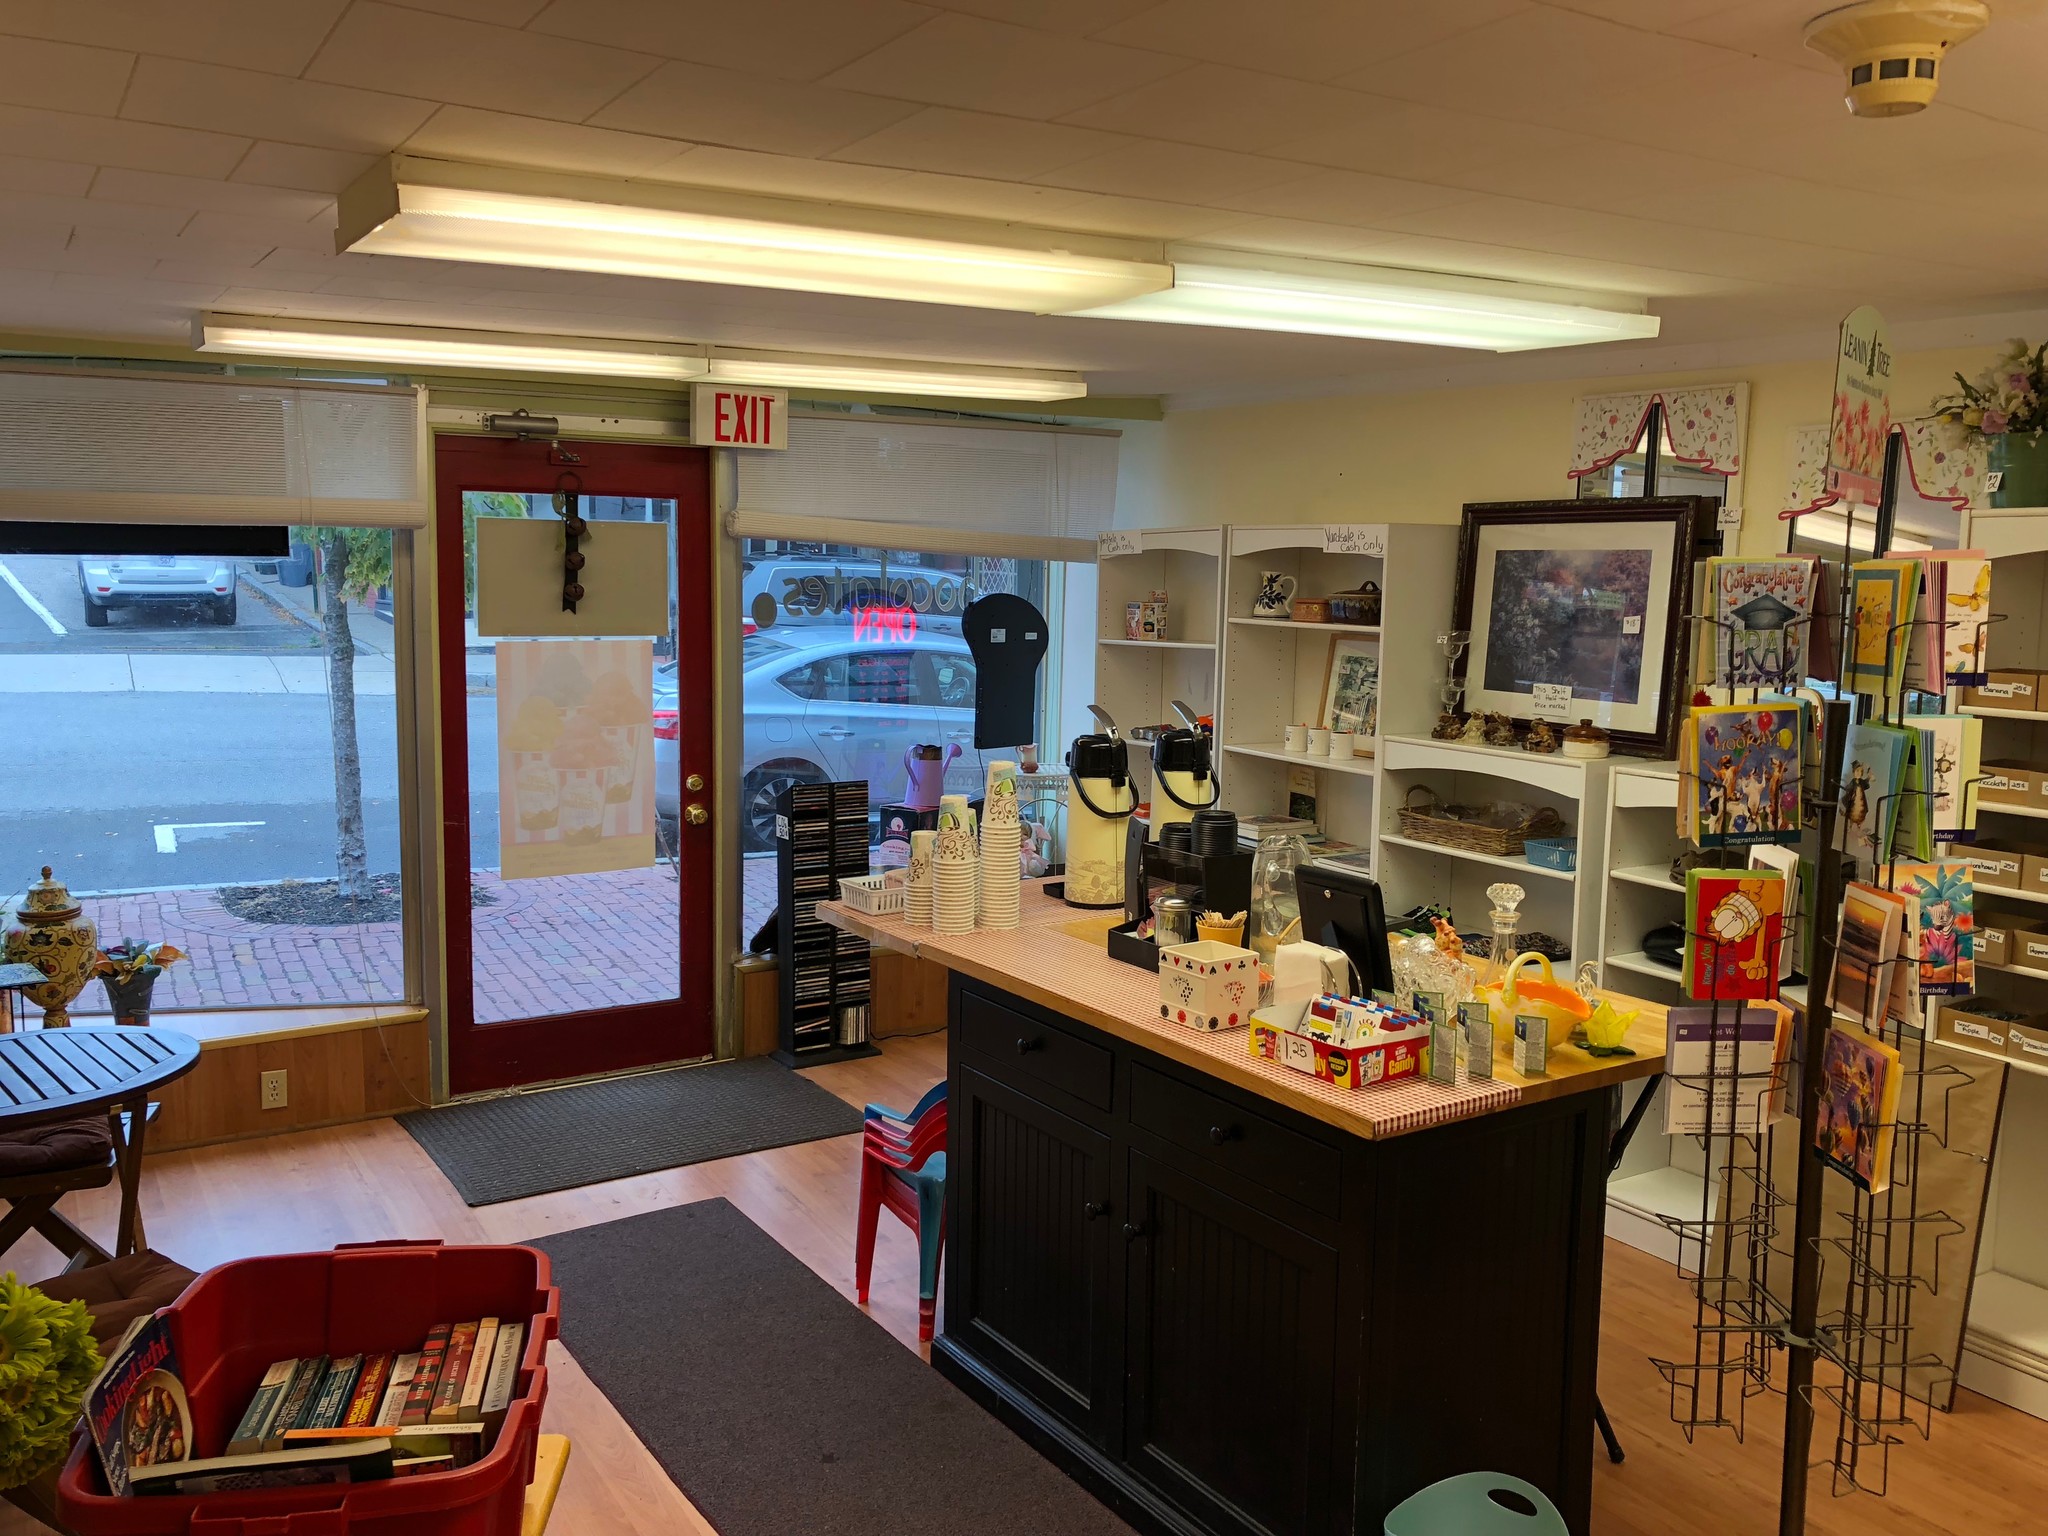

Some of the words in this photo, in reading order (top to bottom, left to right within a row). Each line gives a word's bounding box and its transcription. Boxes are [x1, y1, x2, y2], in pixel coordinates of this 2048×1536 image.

[715, 392, 775, 444] EXIT
[1987, 474, 1998, 490] $2
[1324, 526, 1354, 551] Yardsale
[1357, 530, 1366, 540] is
[1340, 541, 1360, 552] Cash
[1362, 535, 1384, 553] only
[1984, 686, 2009, 695] Banana
[1714, 732, 1781, 751] HOORAY!
[1933, 832, 1955, 840] rthday
[1971, 861, 1998, 872] orehound
[1920, 986, 1949, 994] Birthday
[1285, 1036, 1307, 1060] 1.25
[1388, 1054, 1416, 1076] Candy
